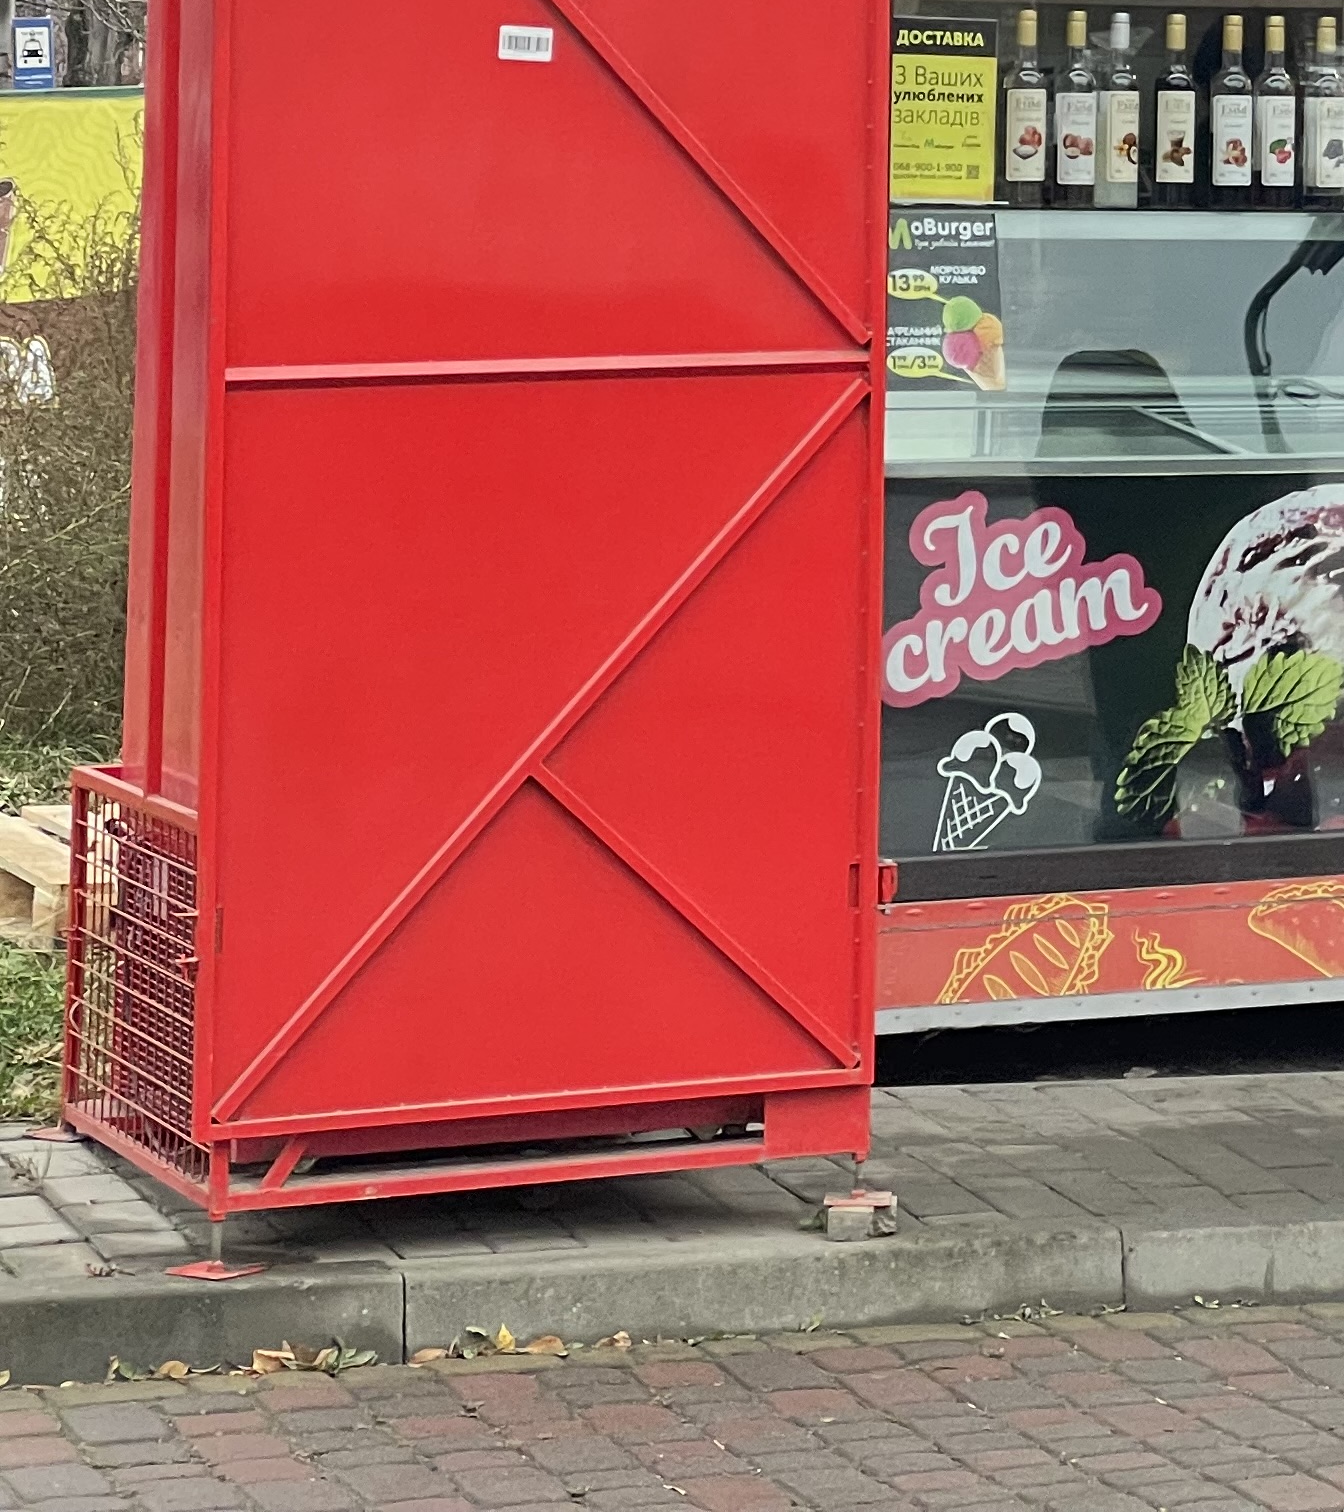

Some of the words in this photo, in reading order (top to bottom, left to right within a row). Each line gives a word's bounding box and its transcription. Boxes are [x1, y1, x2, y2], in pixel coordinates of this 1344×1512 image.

[896, 30, 984, 47] ДОСТАВКА
[895, 65, 906, 85] З
[915, 66, 984, 87] Ваших
[893, 88, 984, 104] улюблених
[930, 265, 986, 276] МОРОЗИВО
[939, 275, 978, 284] КУЛЬКА
[887, 325, 942, 336] АФЕЛЬНИЙ
[922, 505, 1070, 608] Ice
[884, 567, 1149, 693] cream
